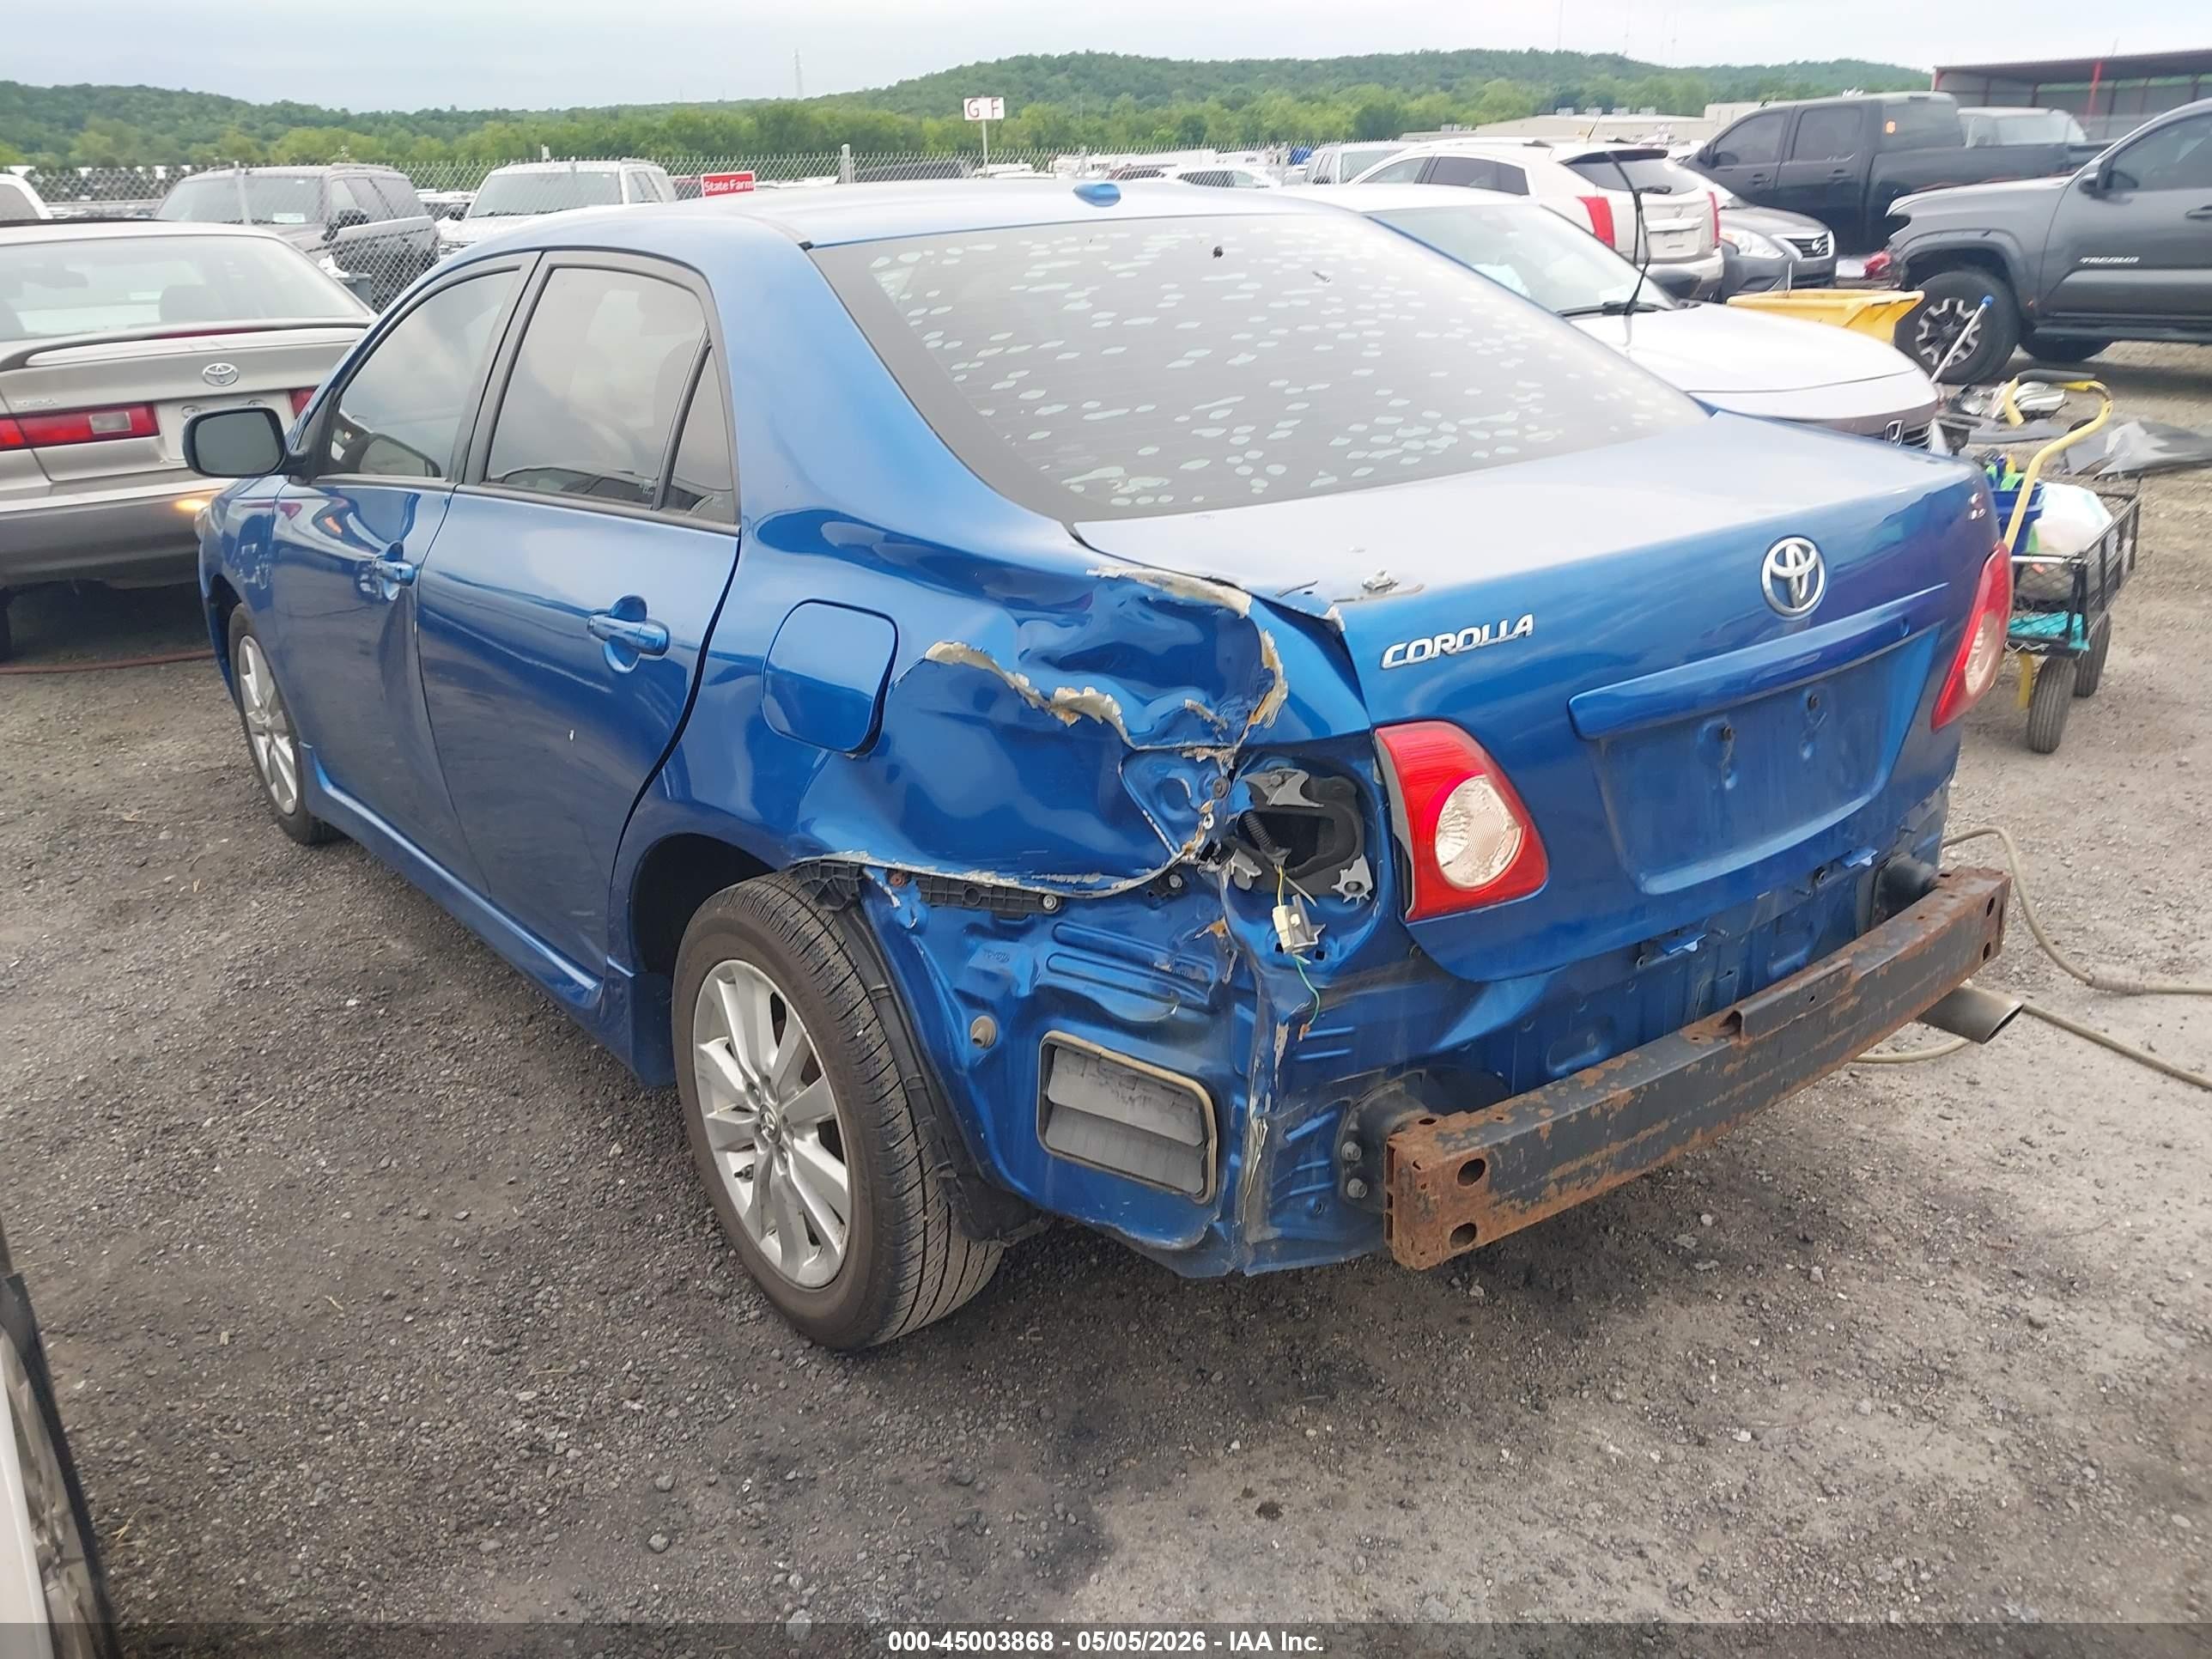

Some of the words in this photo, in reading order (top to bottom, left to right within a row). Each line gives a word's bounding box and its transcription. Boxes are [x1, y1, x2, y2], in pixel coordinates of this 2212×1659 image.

[967, 99, 980, 118] G
[991, 98, 1000, 118] F
[704, 181, 729, 192] State
[729, 179, 755, 191] Farm
[1381, 613, 1534, 670] COROLLA
